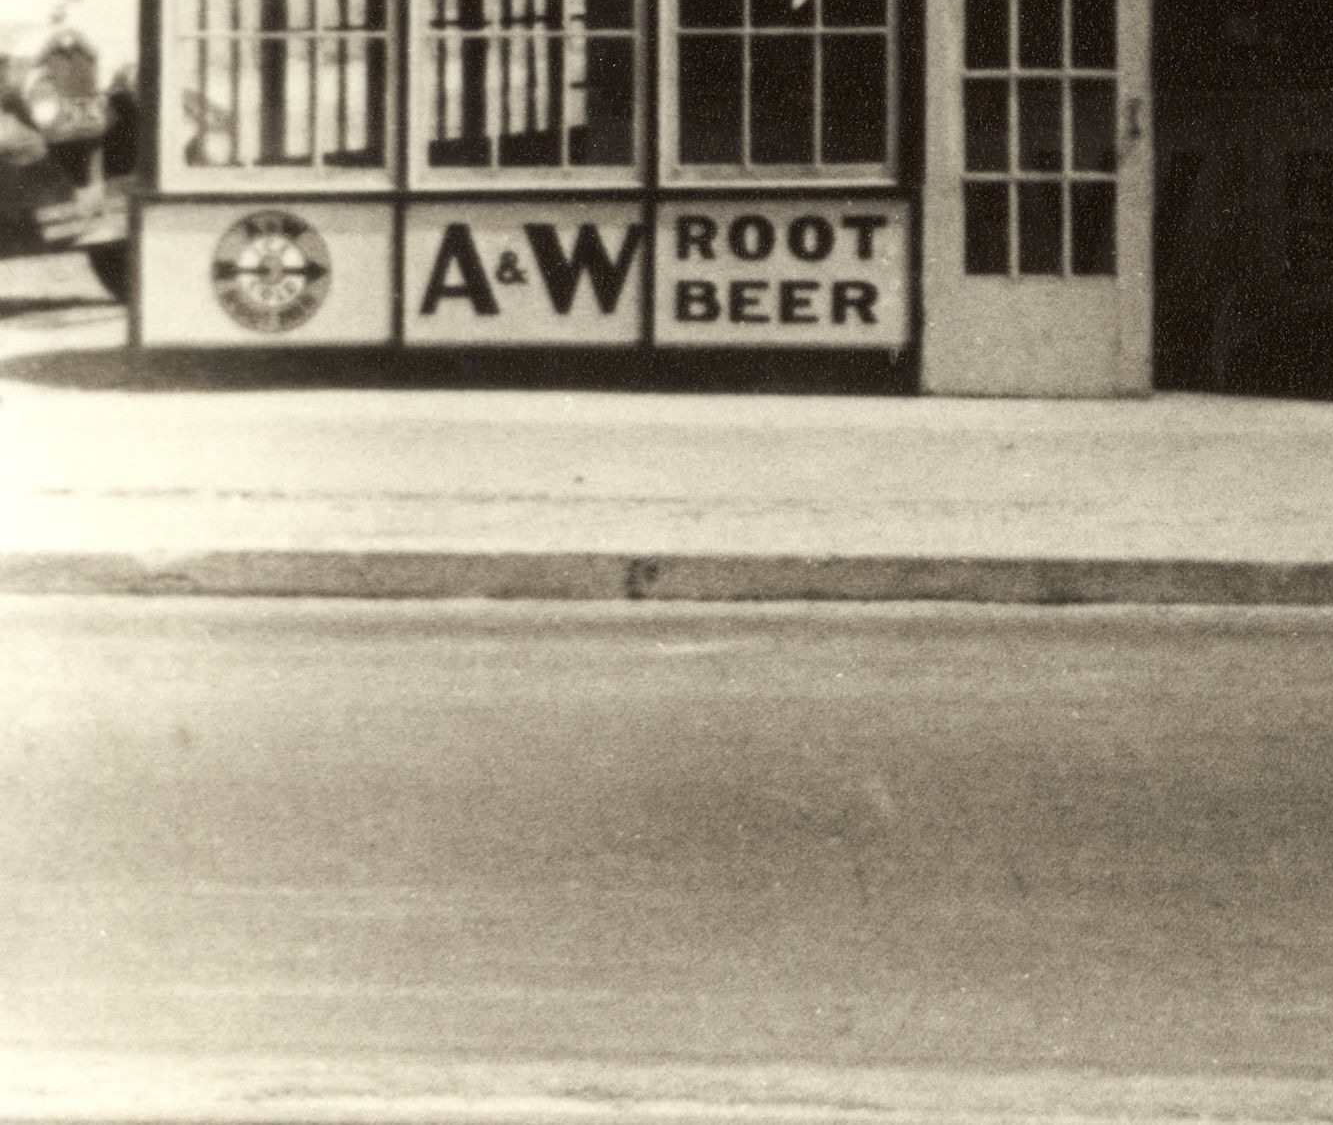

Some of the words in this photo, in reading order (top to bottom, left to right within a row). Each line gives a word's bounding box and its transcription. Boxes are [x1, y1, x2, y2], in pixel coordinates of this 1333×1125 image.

[674, 214, 889, 263] ROOT
[419, 222, 645, 317] A&W
[674, 279, 879, 325] BEER
